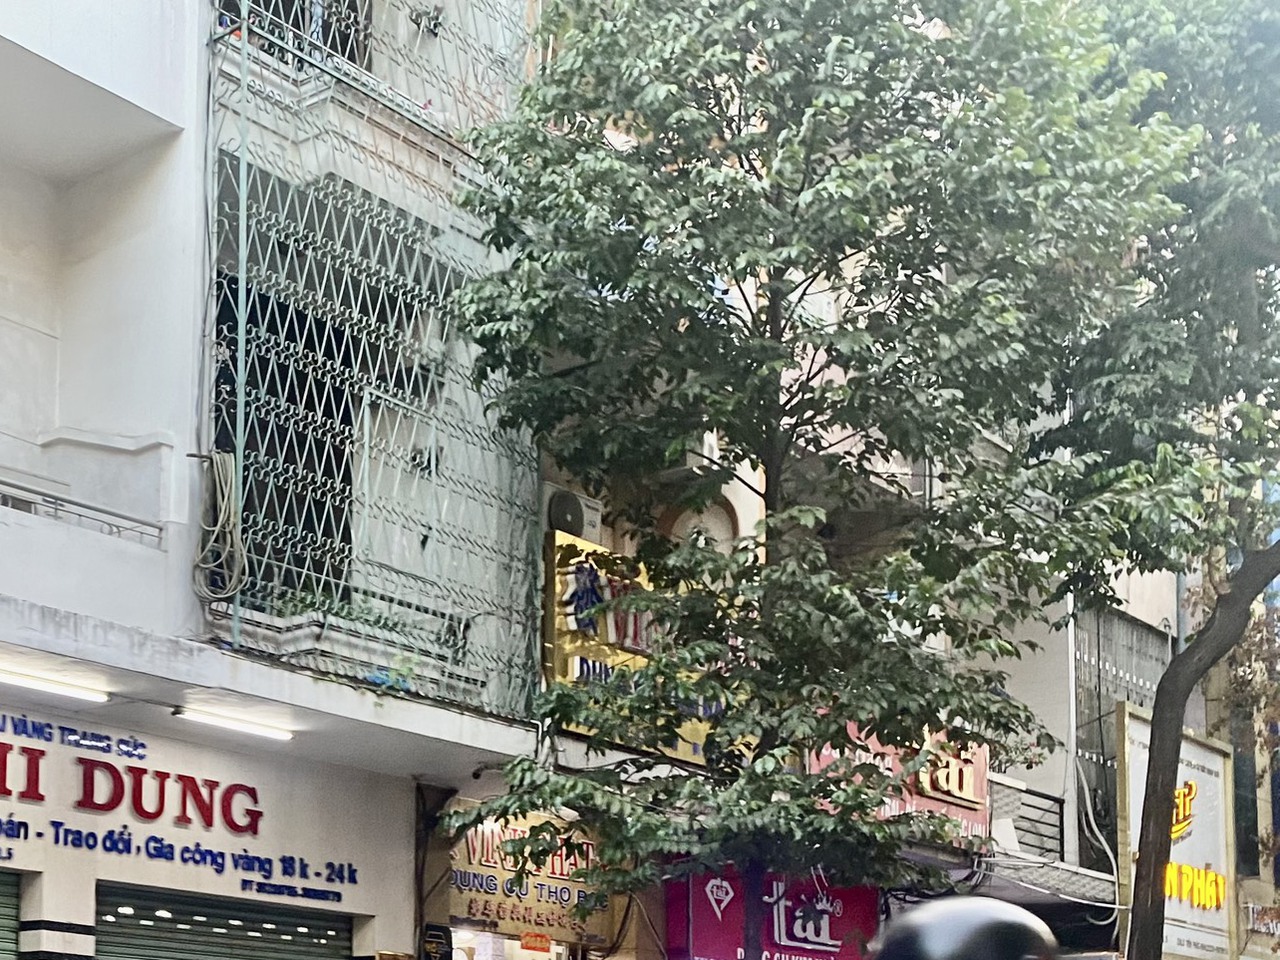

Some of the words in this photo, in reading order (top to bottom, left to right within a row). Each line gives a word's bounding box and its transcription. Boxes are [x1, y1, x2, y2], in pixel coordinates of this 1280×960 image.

[74, 756, 264, 836] DUNG
[50, 821, 98, 850] Trao
[181, 842, 225, 874] công
[231, 848, 273, 880] vàng
